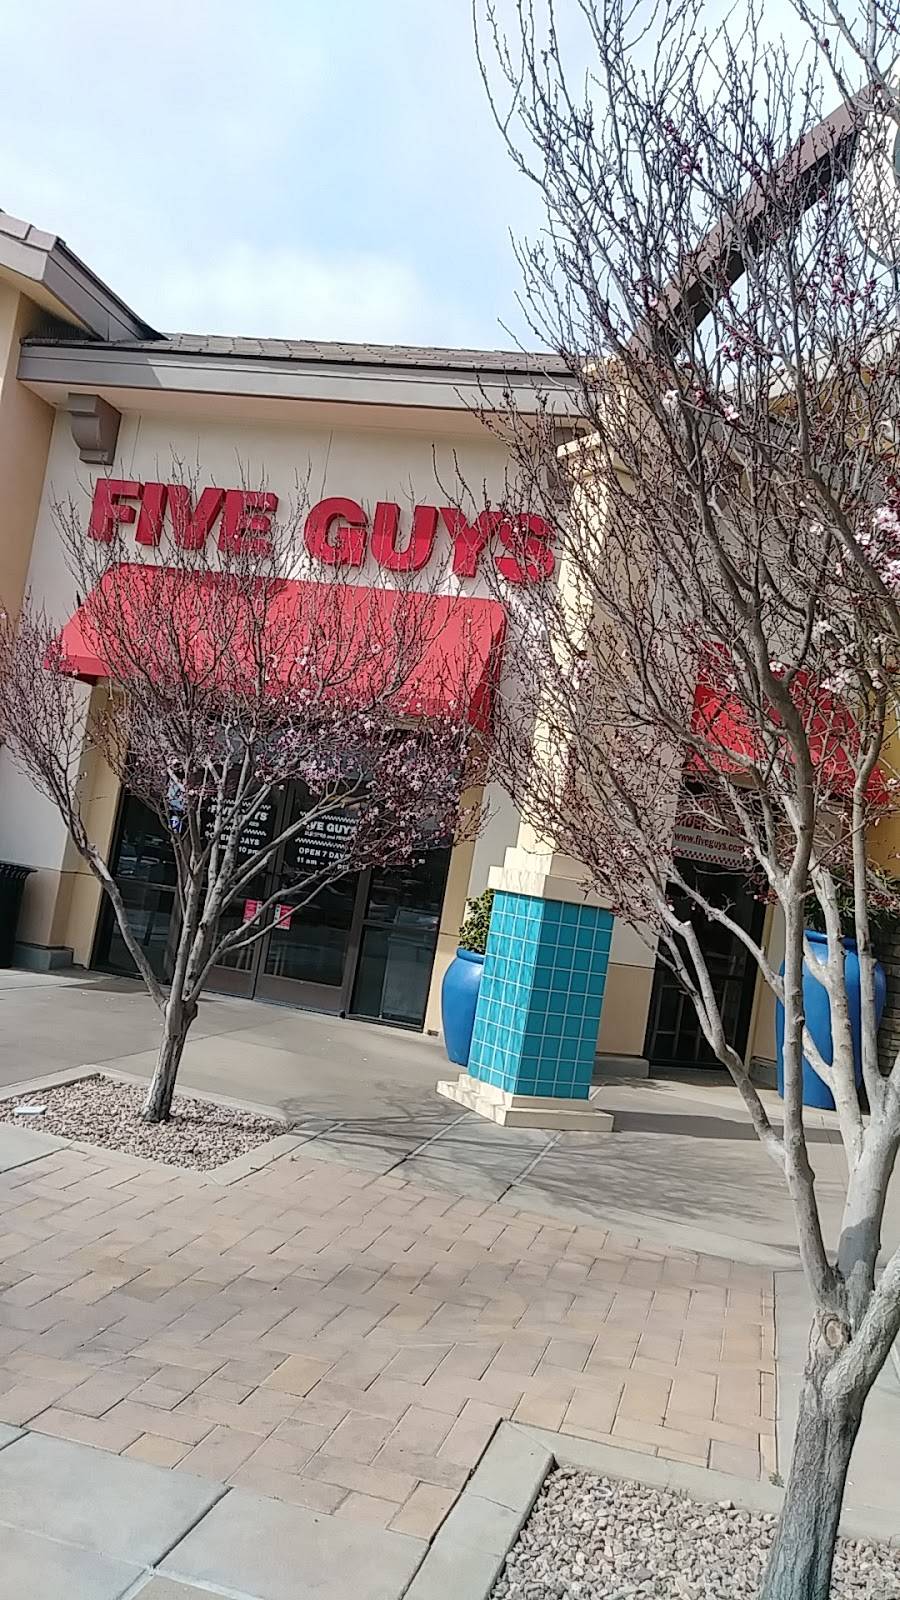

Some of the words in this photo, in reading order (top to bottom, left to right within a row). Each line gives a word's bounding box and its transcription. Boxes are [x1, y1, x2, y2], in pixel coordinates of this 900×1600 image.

[88, 478, 279, 556] FIVE
[304, 497, 556, 583] GUYS
[299, 846, 321, 857] OPEN
